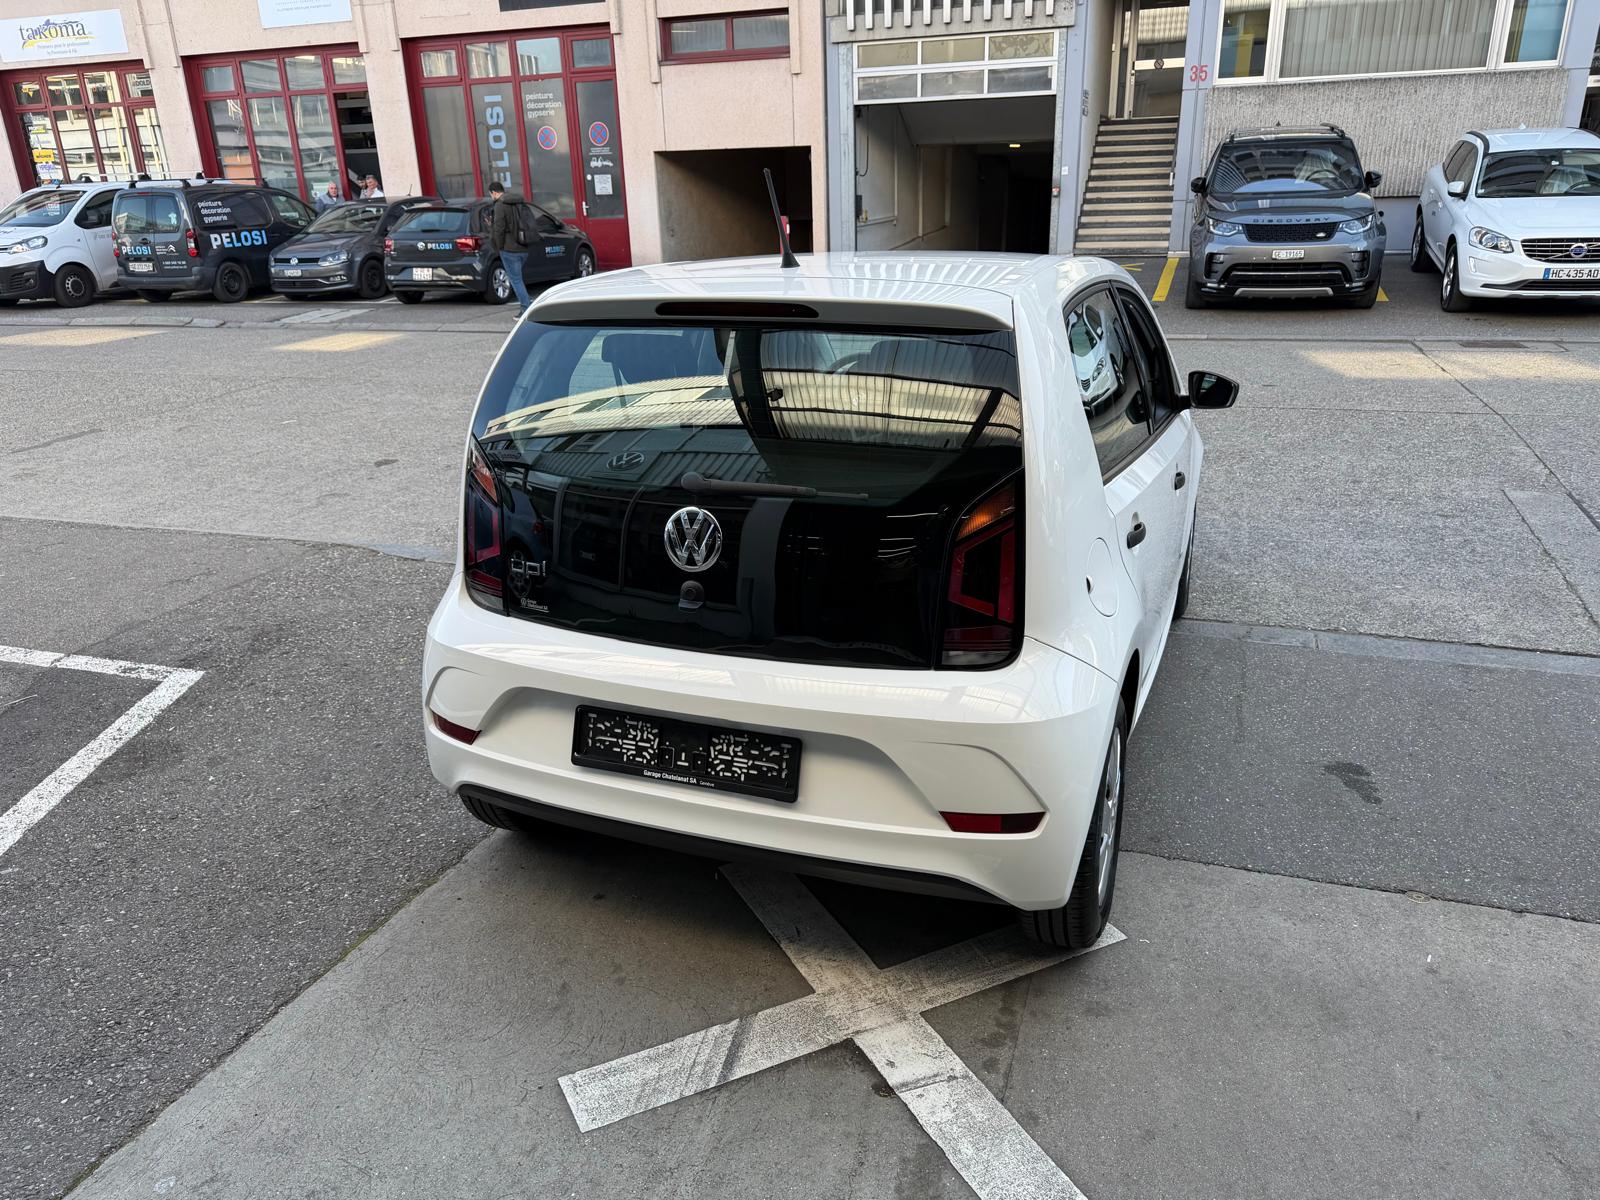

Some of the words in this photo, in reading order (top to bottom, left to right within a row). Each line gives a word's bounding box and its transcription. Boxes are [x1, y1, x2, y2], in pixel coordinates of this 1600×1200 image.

[18, 21, 87, 41] takoma
[1190, 64, 1208, 82] 35
[526, 92, 554, 102] peinture
[526, 101, 562, 110] décoration
[528, 109, 556, 119] gypserie
[484, 94, 512, 188] ELOSI
[197, 200, 223, 208] peinture
[200, 207, 232, 215] décoration
[203, 215, 228, 223] gypserie
[209, 229, 268, 249] PELOSI
[121, 246, 152, 255] PELOSI
[428, 242, 453, 250] PELOSI
[643, 769, 662, 779] Garage
